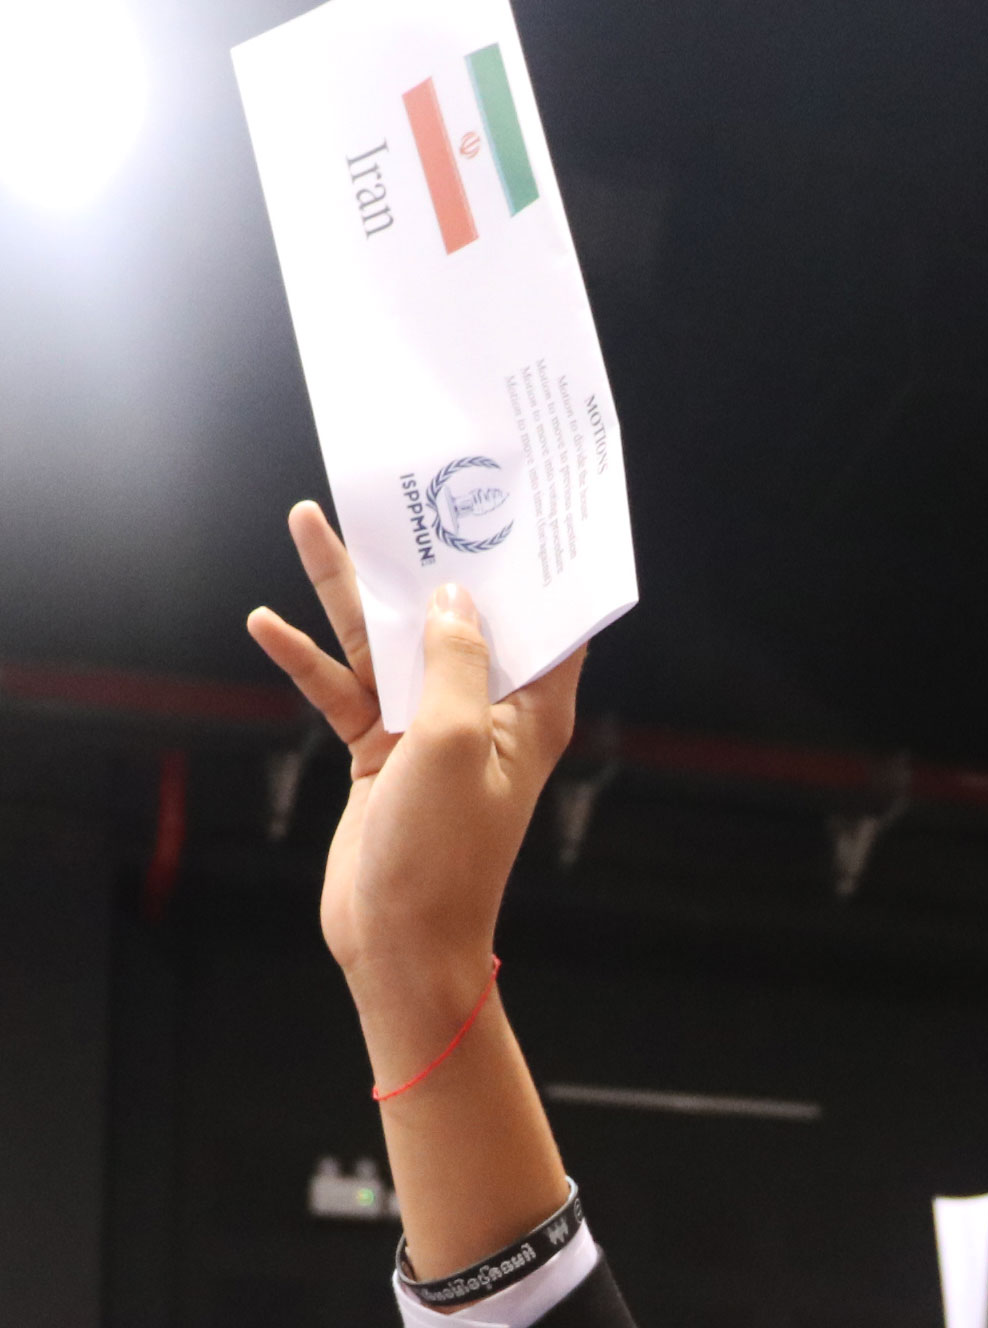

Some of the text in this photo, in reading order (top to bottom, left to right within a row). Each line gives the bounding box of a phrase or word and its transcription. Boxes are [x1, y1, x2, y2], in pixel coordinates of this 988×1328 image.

[345, 136, 394, 239] Iran
[505, 375, 522, 416] Motion
[521, 365, 537, 407] Motion
[536, 358, 553, 400] Motion
[558, 375, 575, 418] Motion
[516, 417, 525, 431] to
[532, 409, 540, 422] to
[546, 401, 555, 414] to
[535, 423, 548, 457] move
[550, 415, 563, 450] move
[569, 419, 578, 432] to
[584, 393, 608, 475] MOTIONS
[519, 432, 533, 465] move
[559, 450, 567, 463] to
[573, 434, 587, 469] divide
[528, 467, 538, 491] into
[543, 457, 553, 481] into
[400, 473, 435, 561] ISPPMUN
[548, 517, 564, 574] procedure
